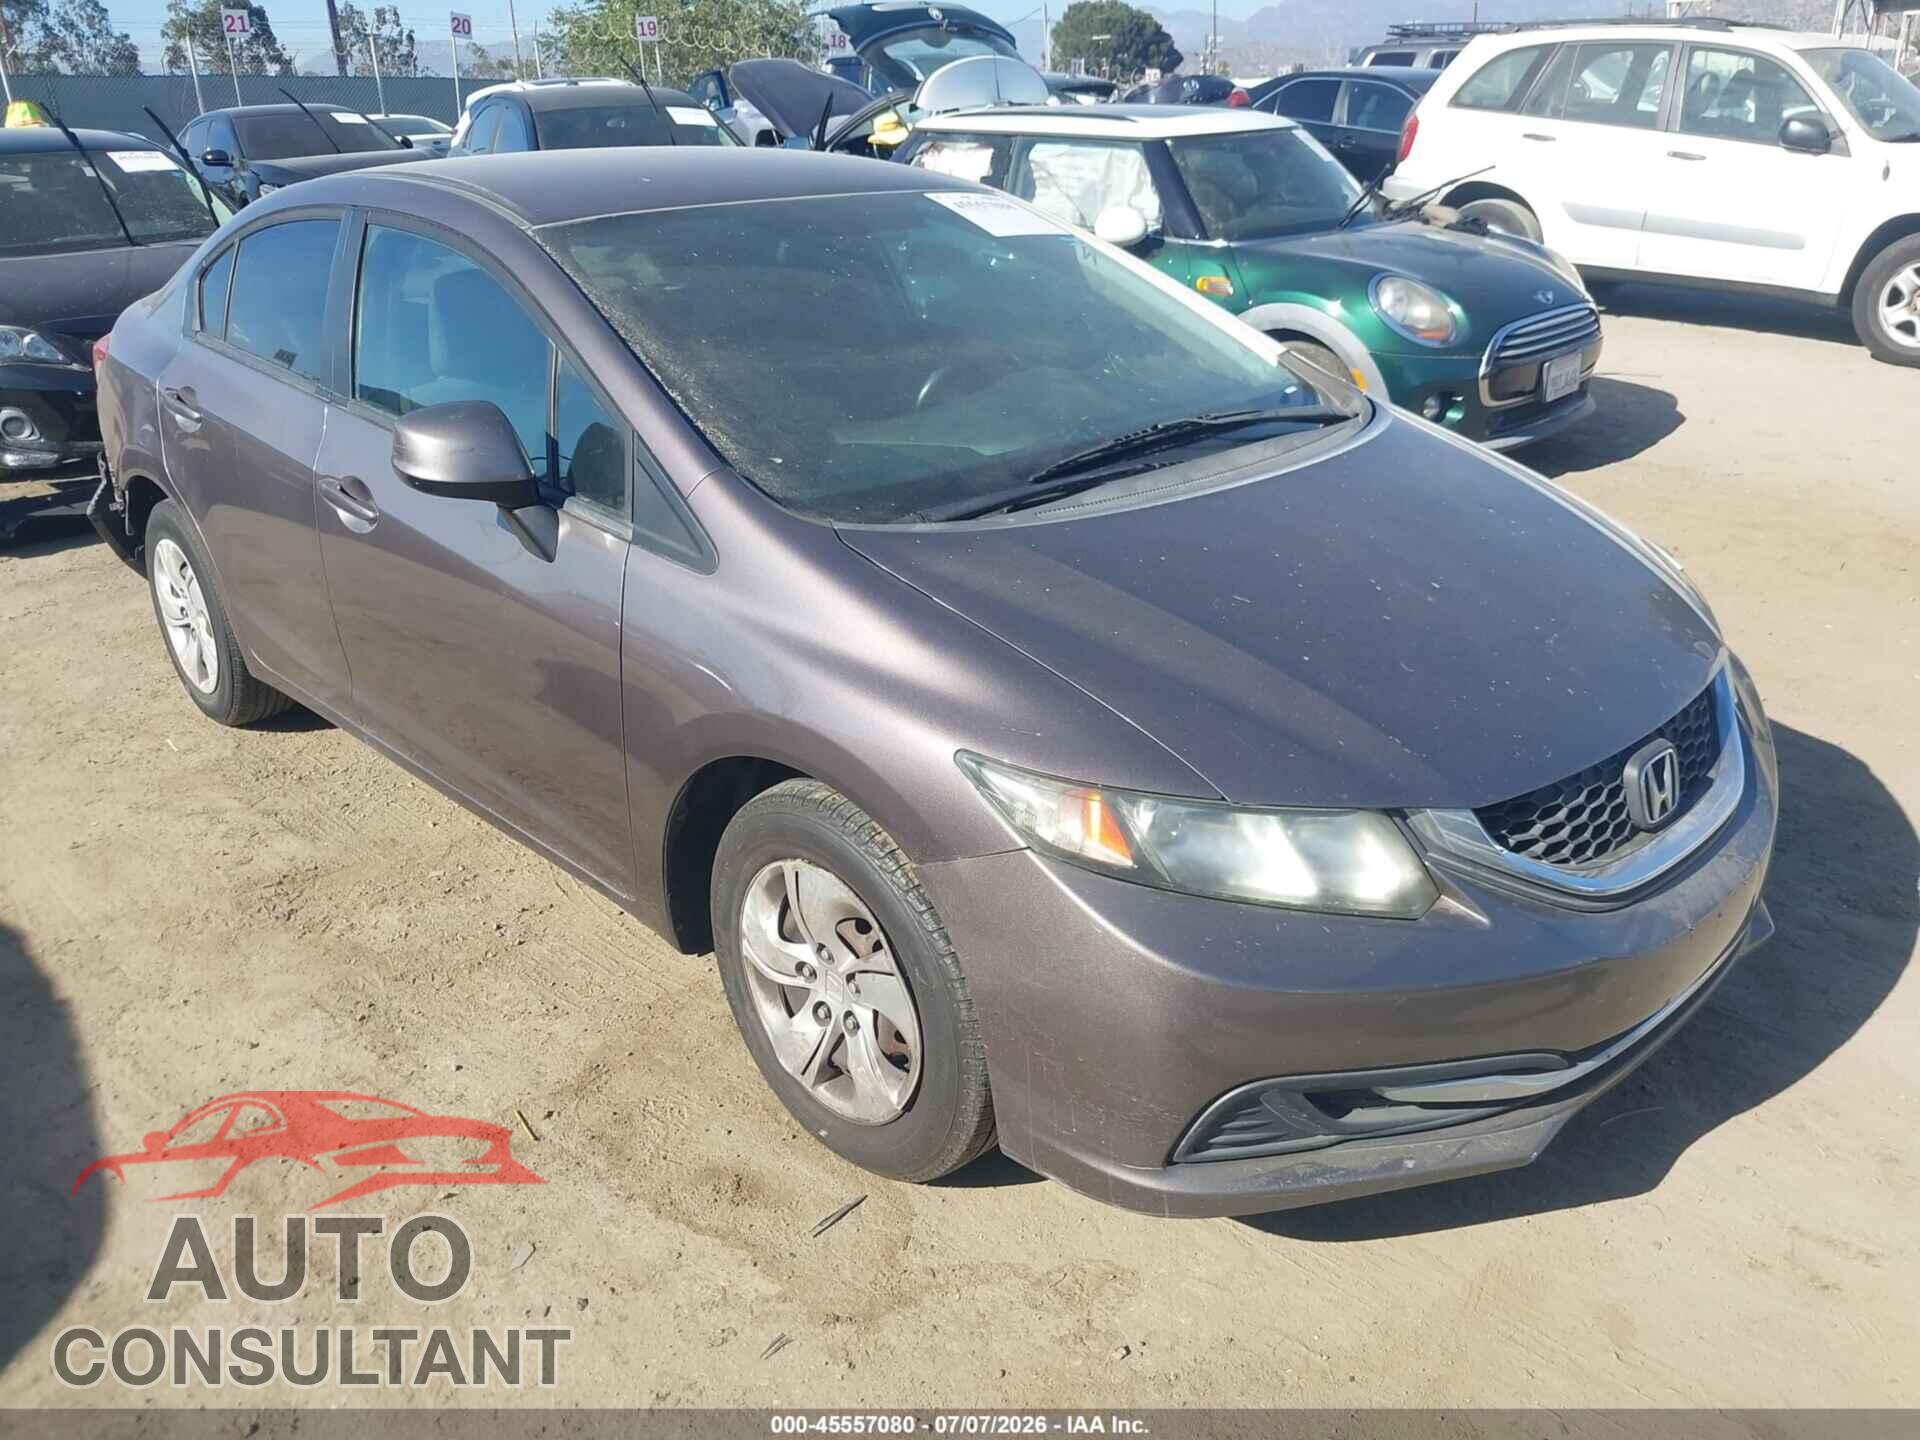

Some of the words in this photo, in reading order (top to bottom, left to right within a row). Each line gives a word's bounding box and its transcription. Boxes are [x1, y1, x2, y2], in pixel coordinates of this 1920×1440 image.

[224, 15, 249, 33] 21
[452, 17, 471, 35] 20
[638, 21, 657, 37] 19
[830, 34, 846, 48] 18
